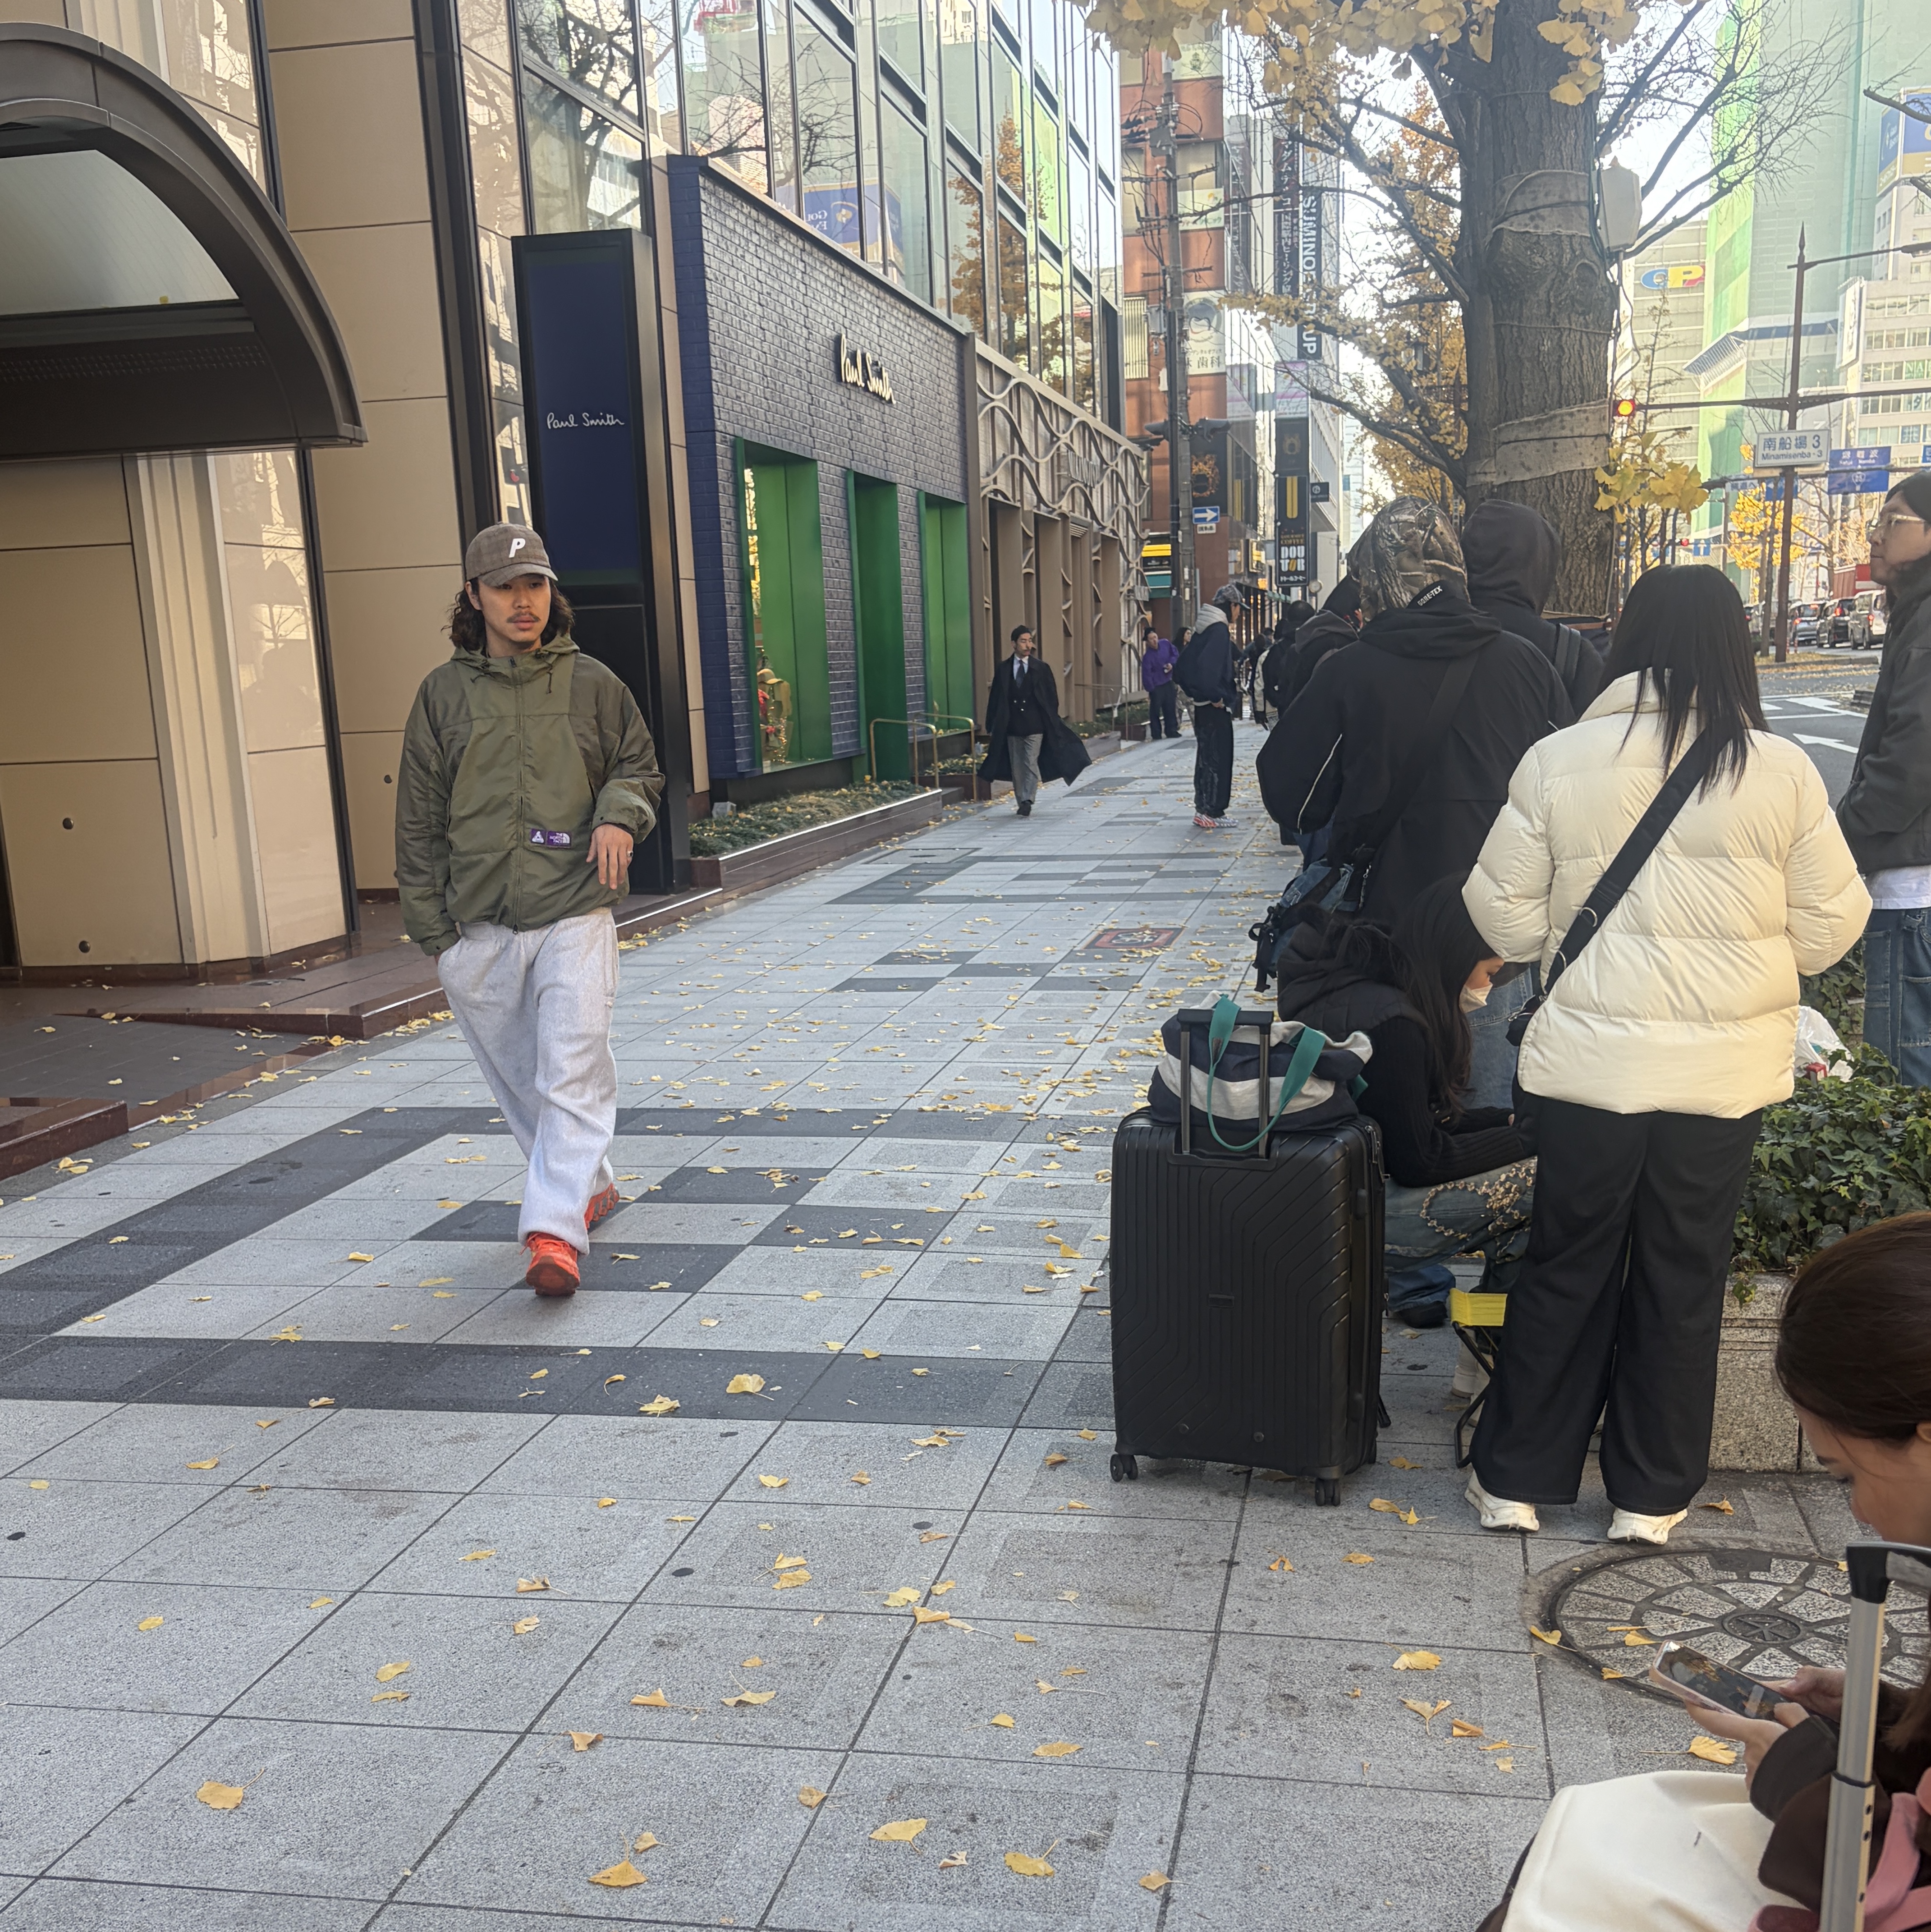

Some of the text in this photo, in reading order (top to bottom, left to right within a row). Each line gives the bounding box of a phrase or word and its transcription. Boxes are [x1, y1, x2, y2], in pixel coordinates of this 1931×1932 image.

[841, 334, 896, 404] Paul Smith
[546, 412, 625, 429] Paul Smith
[1763, 434, 1821, 451] 南船場 3
[1817, 450, 1823, 458] 3
[509, 538, 526, 558] P
[1281, 546, 1305, 559] DOU
[1417, 585, 1443, 606] GORE-TEX
